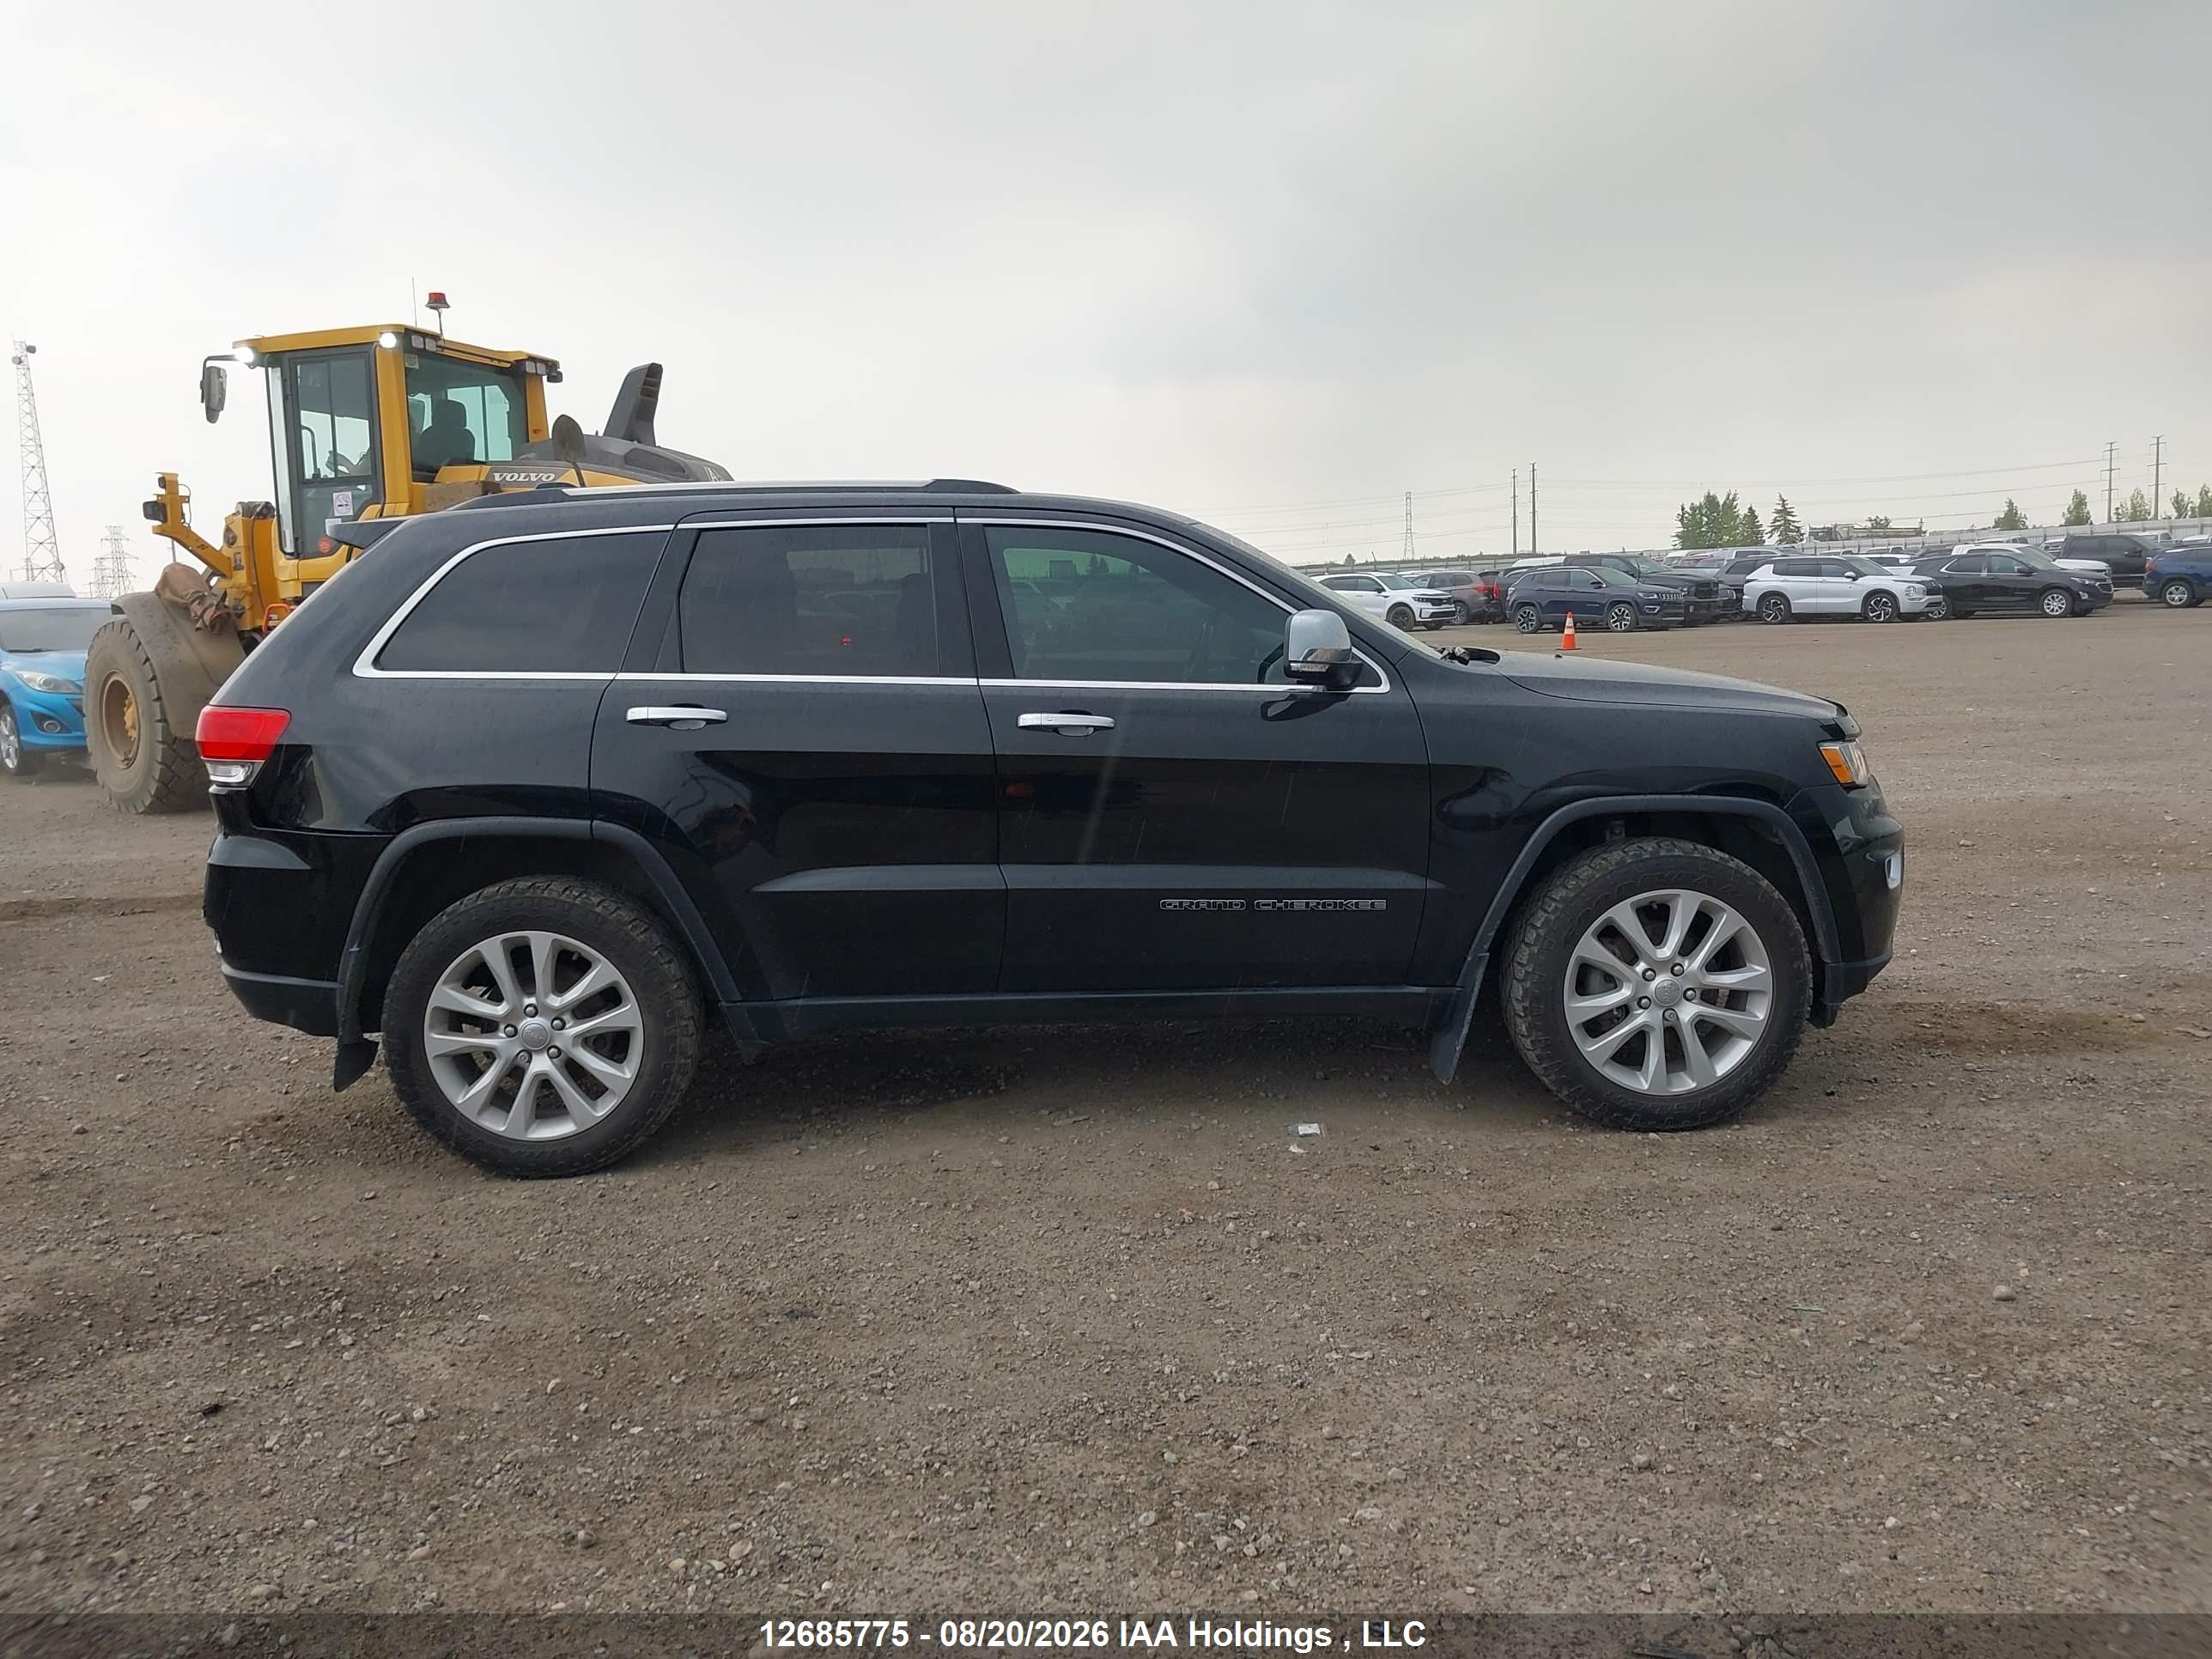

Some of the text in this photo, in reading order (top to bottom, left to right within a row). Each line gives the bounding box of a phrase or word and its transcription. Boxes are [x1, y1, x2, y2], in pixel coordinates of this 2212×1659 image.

[492, 472, 556, 482] VOLVO
[1159, 898, 1387, 911] GRAND CHEROKEE
